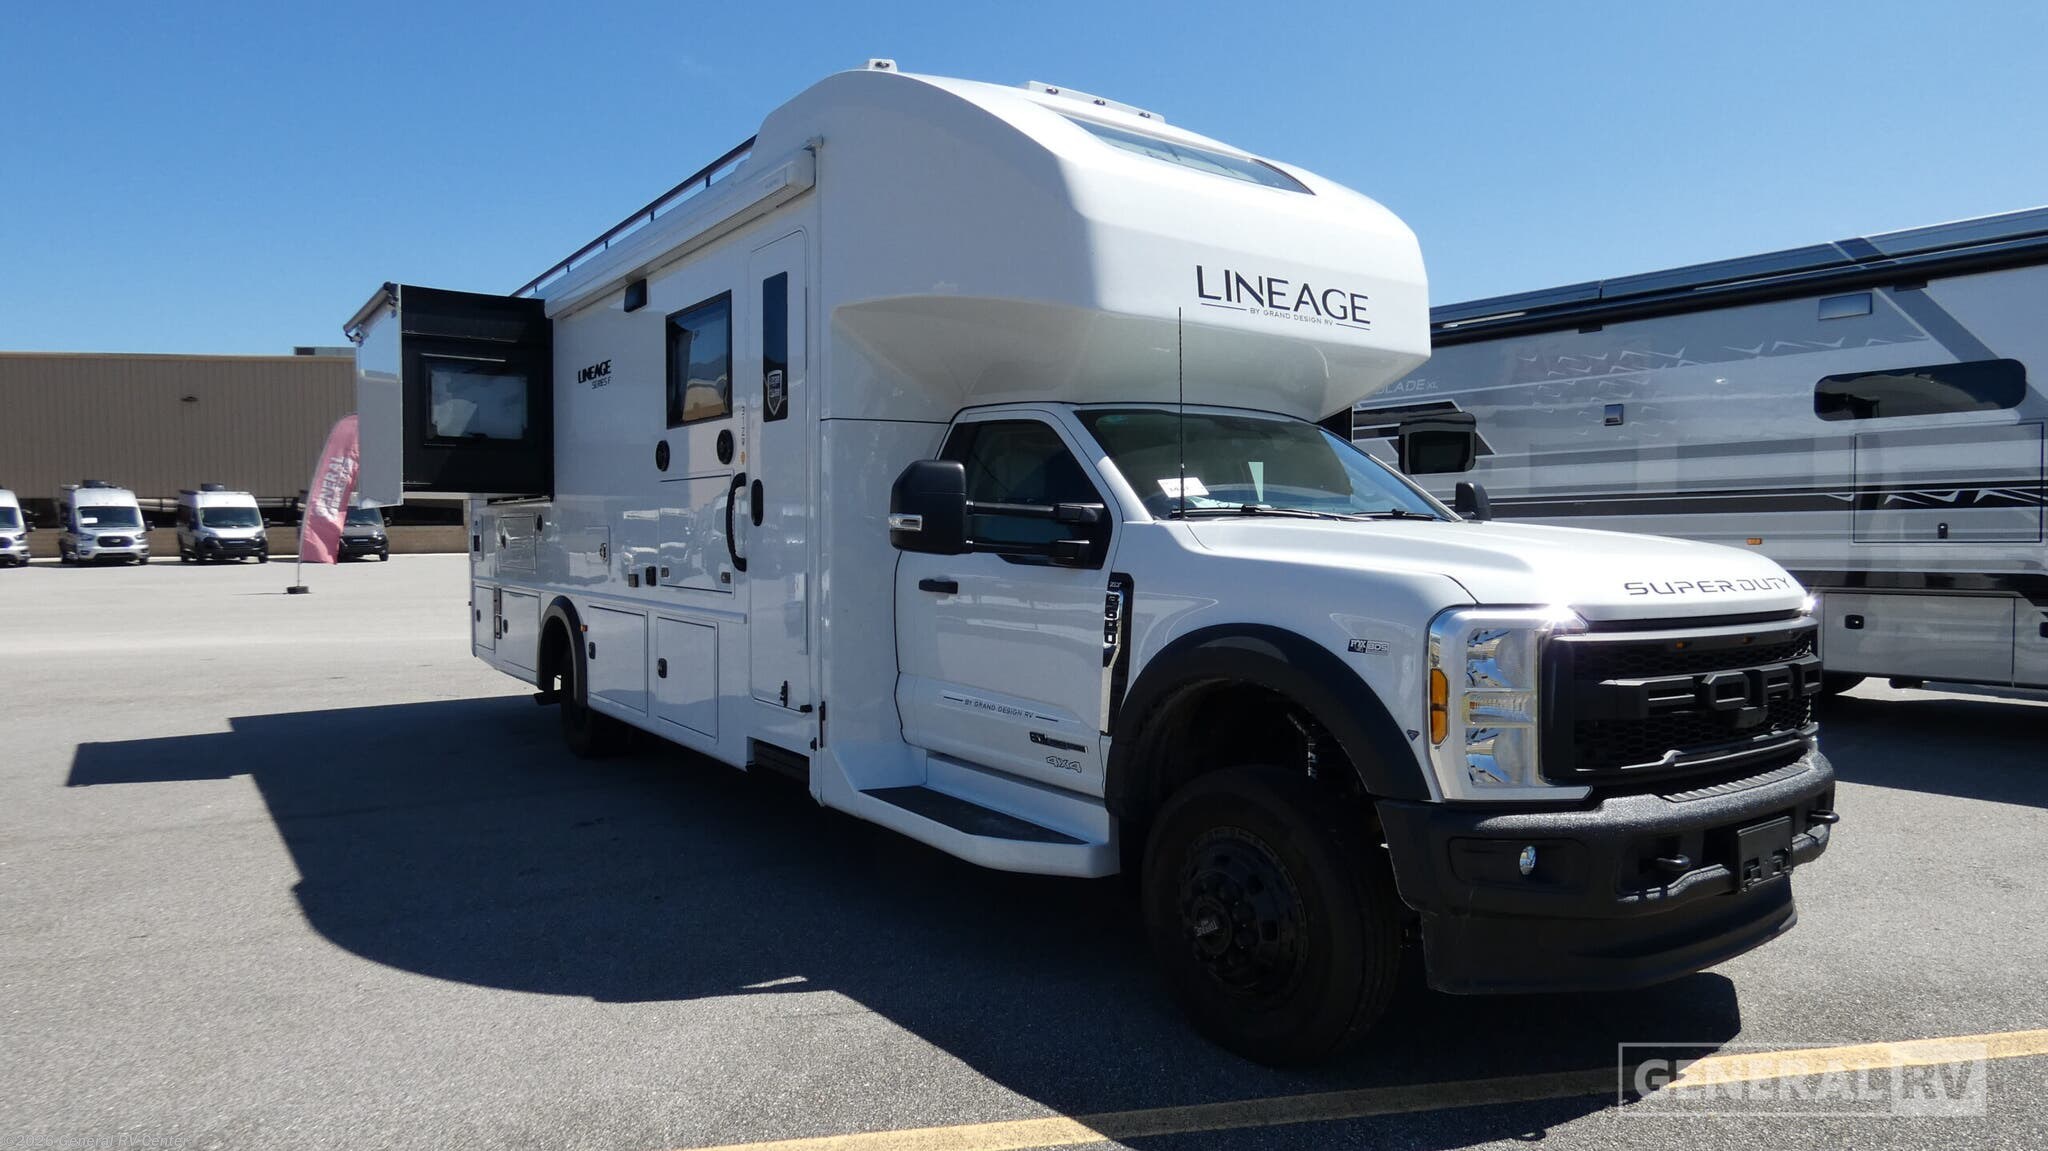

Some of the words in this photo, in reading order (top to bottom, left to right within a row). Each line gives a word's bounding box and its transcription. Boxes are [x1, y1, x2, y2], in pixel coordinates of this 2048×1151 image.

[1196, 265, 1371, 325] LINEAGE
[1263, 309, 1291, 319] GRAND
[1294, 314, 1322, 325] DESIGN
[1324, 318, 1334, 326] RV
[577, 359, 612, 384] LINEAGE
[1376, 379, 1427, 394] LADE
[1624, 579, 1736, 596] SUPER
[1735, 576, 1791, 592] DUTY
[974, 701, 996, 711] GRAND
[998, 706, 1022, 717] DESIGN
